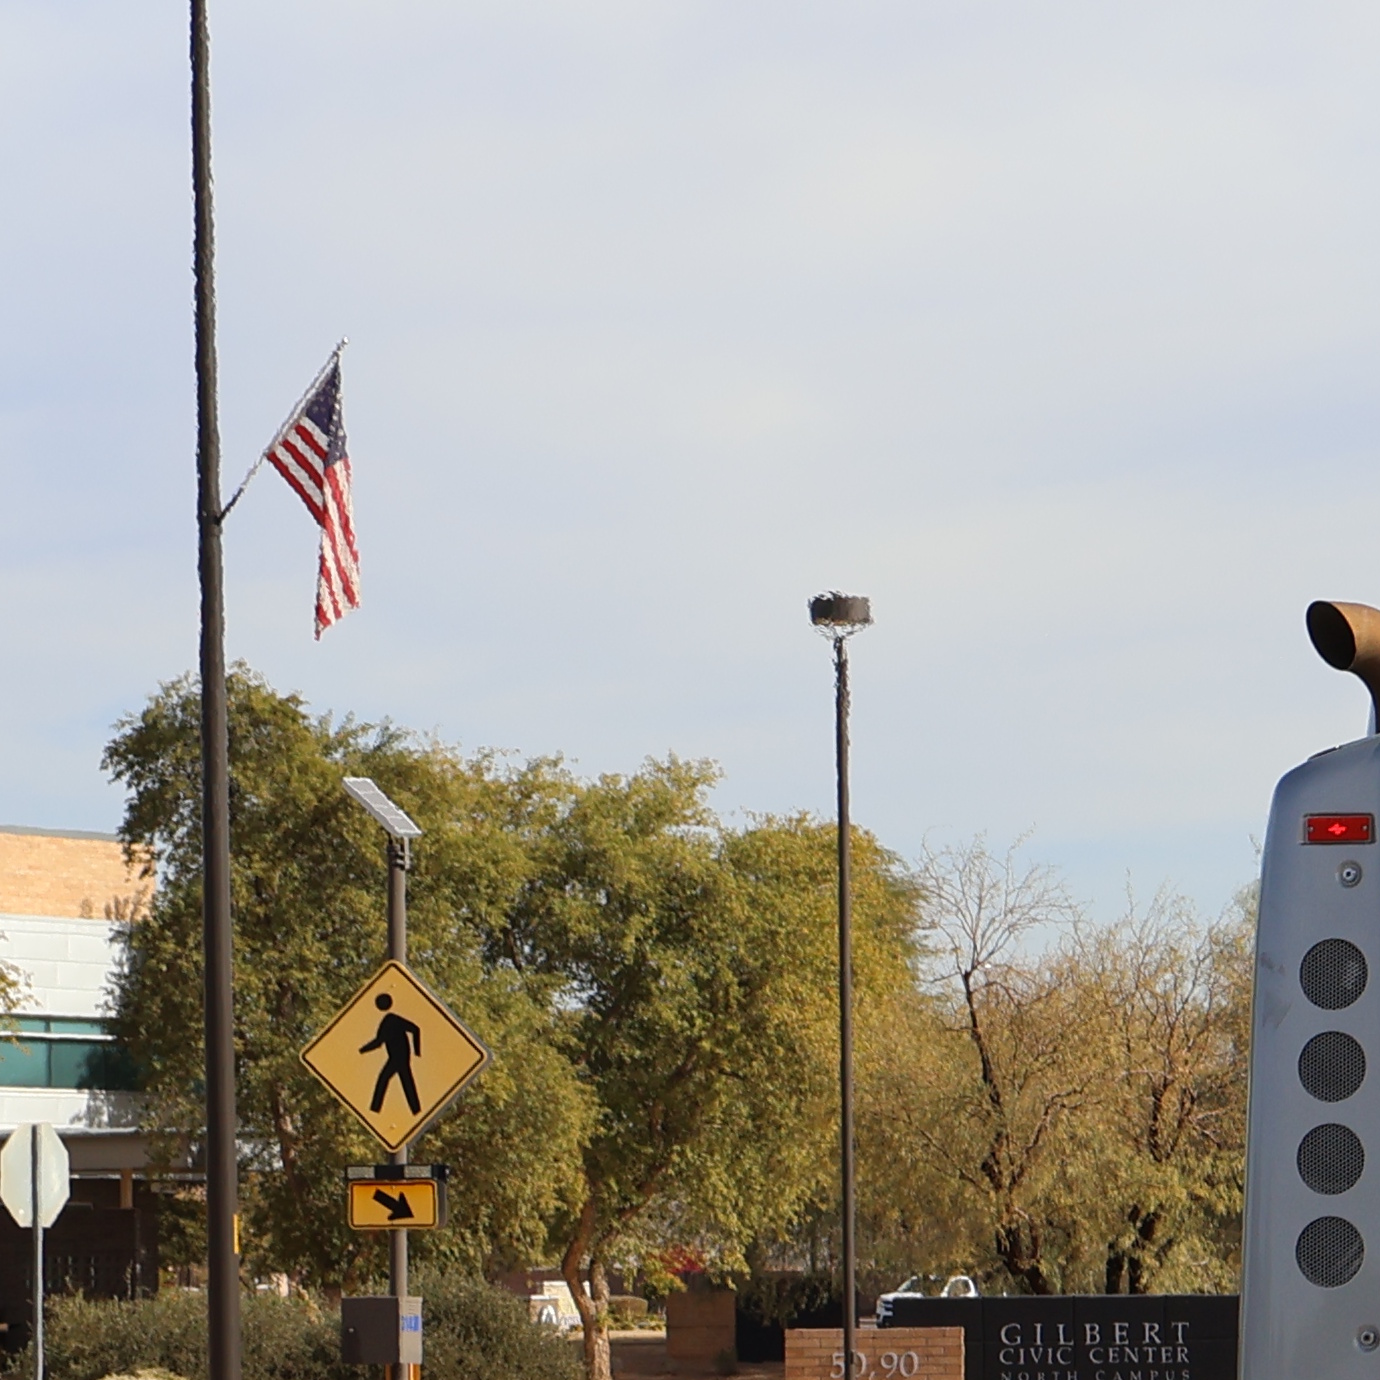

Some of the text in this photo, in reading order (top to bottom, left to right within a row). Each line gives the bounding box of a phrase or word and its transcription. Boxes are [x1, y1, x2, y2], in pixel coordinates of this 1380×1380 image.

[1001, 1322, 1190, 1346] GILBERT
[1000, 1347, 1190, 1365] CIVIC CENTER
